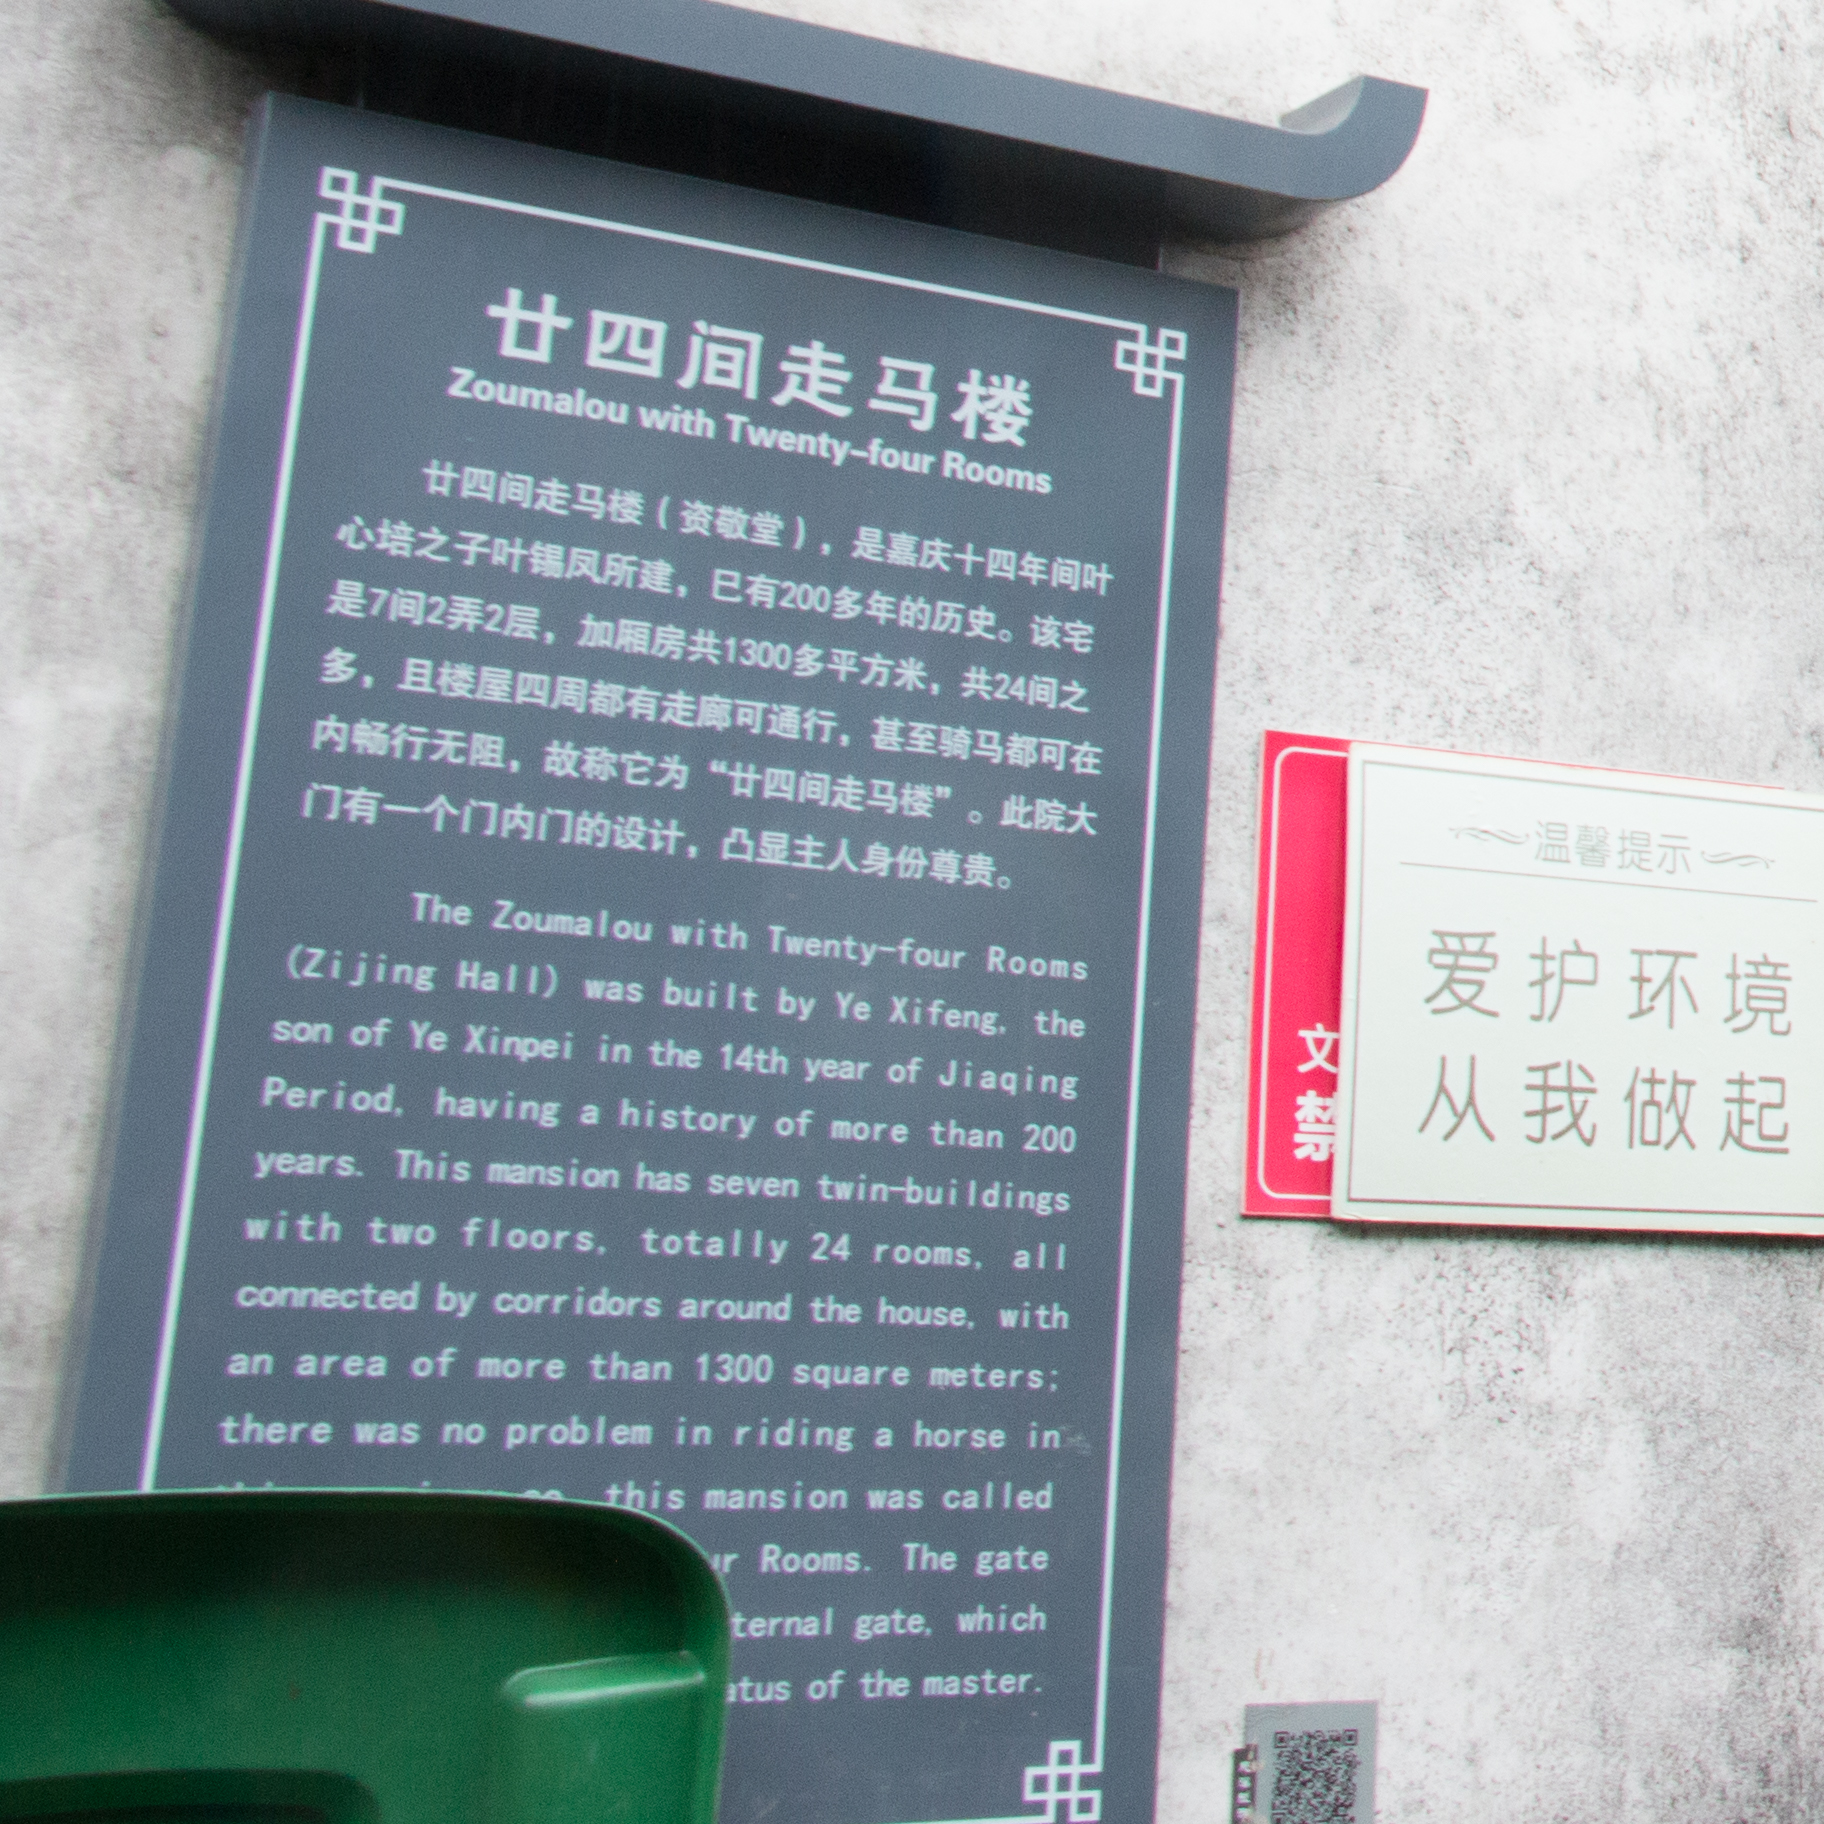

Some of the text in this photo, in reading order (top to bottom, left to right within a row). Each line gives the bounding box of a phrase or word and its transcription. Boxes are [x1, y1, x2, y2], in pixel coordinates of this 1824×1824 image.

[484, 285, 1034, 448] 廿四间走马楼
[445, 364, 1055, 497] Zoumalou with Twenty-four Rooms
[1534, 818, 1692, 876] 温馨提示
[410, 890, 1090, 983] The Zoumalou with Twenty-four Rooms
[285, 942, 439, 995] (Zijing
[455, 958, 560, 1000] Hall)
[582, 977, 646, 1006] was
[661, 975, 760, 1015] built
[776, 985, 818, 1024] by
[833, 989, 874, 1023] Ye
[1032, 1007, 1088, 1041] the
[1424, 929, 1793, 1037] 爱护环境
[270, 1015, 1080, 1103] son of Ye Xinpei in the 14th year of Jiaqing
[433, 1085, 563, 1131] having
[577, 1102, 602, 1127] a
[618, 1096, 759, 1142] history
[773, 1107, 816, 1139] of
[828, 1118, 911, 1146] more
[928, 1117, 1006, 1151] than
[1021, 1121, 1079, 1156] 200
[1418, 1053, 1791, 1155] 从我做起
[253, 1146, 1073, 1218] years. This mansion has seven twin-buildings
[243, 1208, 344, 1245] with
[366, 1215, 439, 1248] two
[639, 1226, 791, 1267] totally
[809, 1229, 853, 1263] 24
[1011, 1240, 1068, 1272] all
[234, 1279, 423, 1314] connected
[433, 1280, 480, 1321] by
[491, 1284, 664, 1320] corridors
[677, 1291, 794, 1324] around
[807, 1293, 864, 1326] the
[997, 1299, 1071, 1332] with
[225, 1344, 1059, 1394] an area of more than 1300 square meters;
[218, 1410, 1063, 1455] there was no problem in riding a horse in
[604, 1480, 687, 1514] this
[702, 1479, 850, 1512] mansion
[865, 1487, 926, 1512] was
[940, 1479, 1055, 1512] called
[758, 1541, 873, 1576] Rooms.
[901, 1540, 960, 1574] The
[973, 1543, 1051, 1579] gate
[728, 1605, 836, 1641] ternal
[955, 1601, 1049, 1635] which
[724, 1667, 1043, 1706] atus of the master.
